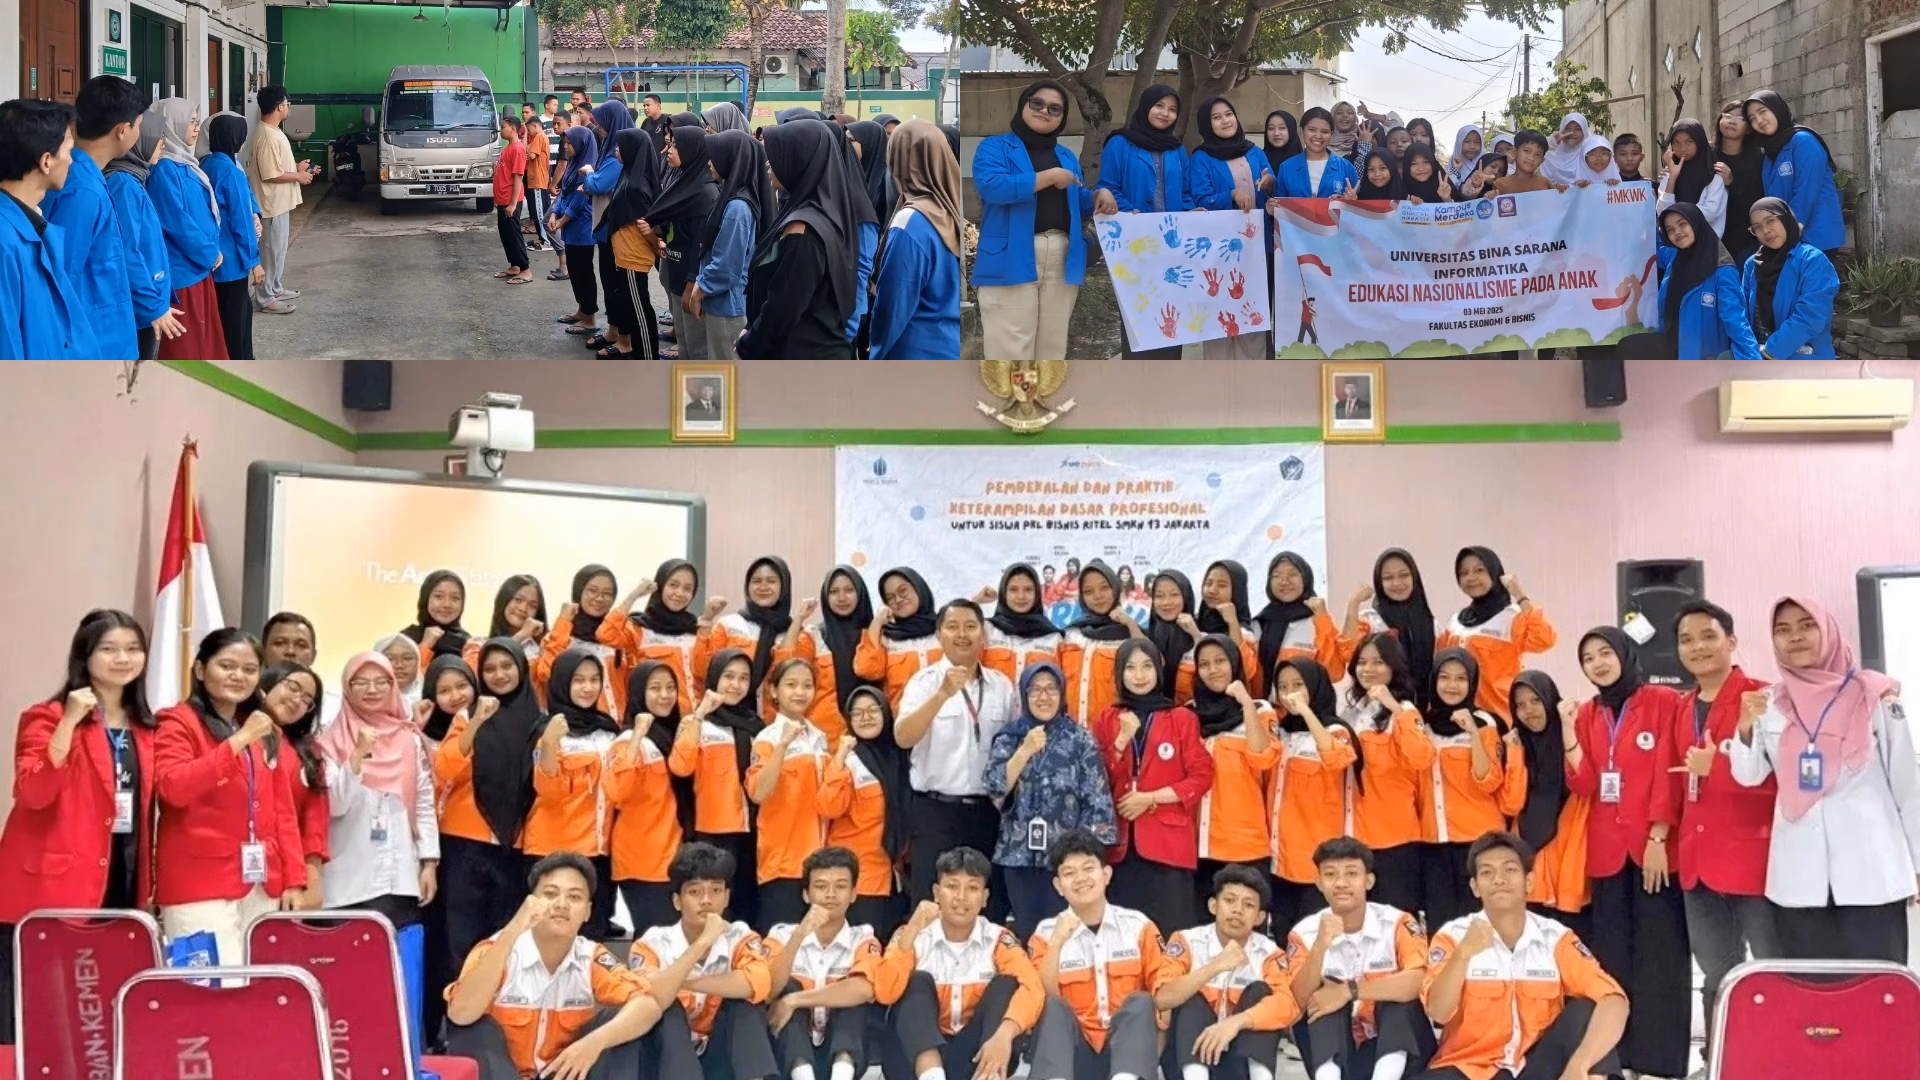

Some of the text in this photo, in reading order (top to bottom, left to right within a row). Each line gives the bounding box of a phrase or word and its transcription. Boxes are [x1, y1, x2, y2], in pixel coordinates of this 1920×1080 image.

[105, 53, 126, 69] KANTOR
[1606, 187, 1647, 204] #MKWK
[1434, 202, 1472, 214] Kampus
[1434, 209, 1475, 222] Merdeka
[1390, 239, 1567, 263] UNIVERSITAS BINA SARANA
[1434, 262, 1528, 279] INFORMATIKA
[1348, 269, 1598, 303] EDUKASI NASIONALISME PADA ANAK
[1463, 306, 1504, 316] 03 MEI 2025
[1428, 313, 1536, 331] FAKULTAS EKONOMI & BISNIS
[985, 478, 1174, 495] PEMBEKALAN DAN PRAKTIK
[949, 501, 1207, 516] KETERAMPILAN DASAR PROFESIONAL
[951, 520, 985, 530] UNTUK
[988, 520, 1020, 530] SISWA
[1046, 520, 1079, 530] BISNIS
[1082, 519, 1112, 530] RITEL
[1115, 519, 1145, 530] SMKN
[1147, 518, 1160, 529] 13
[1163, 519, 1210, 530] JAKARTA
